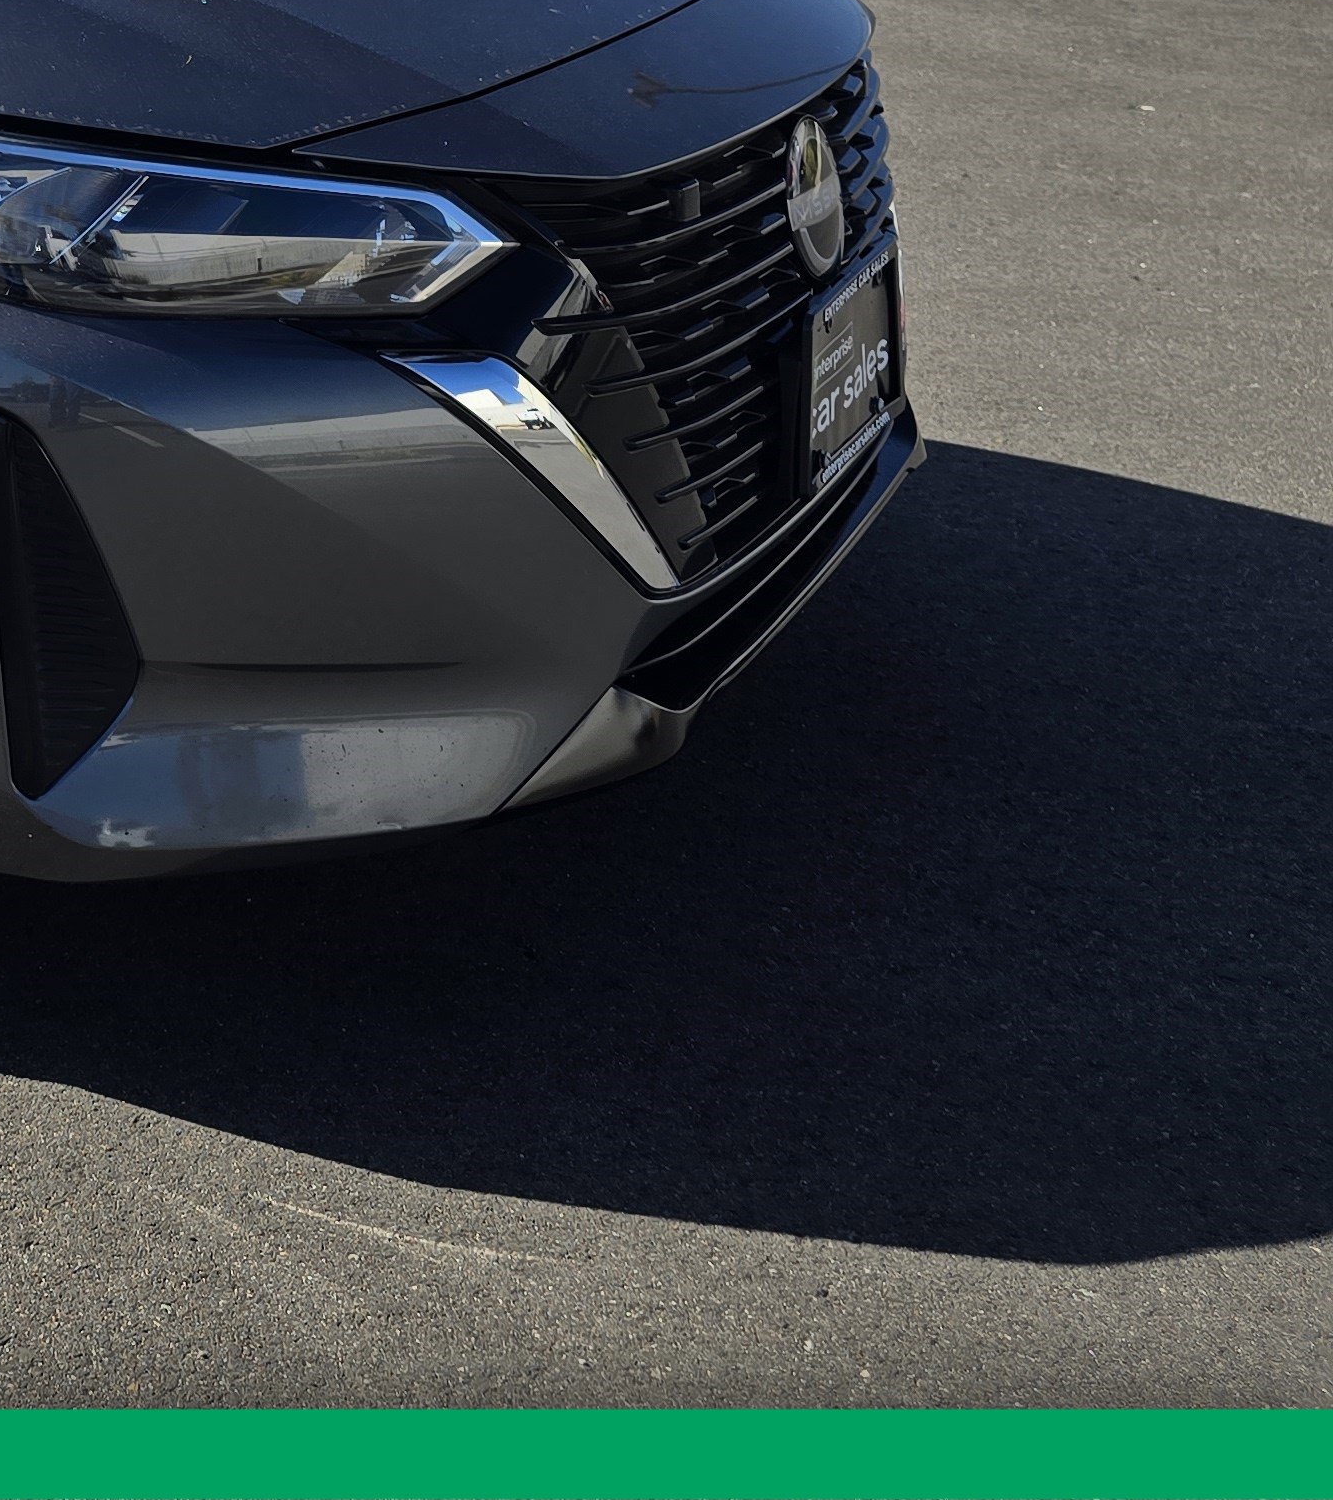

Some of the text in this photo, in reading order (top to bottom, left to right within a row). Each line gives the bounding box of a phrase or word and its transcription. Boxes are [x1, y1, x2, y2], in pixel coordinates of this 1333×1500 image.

[824, 250, 890, 322] ENTERPRISE CAR SALES
[843, 338, 889, 409] sales
[821, 411, 891, 484] enterprisecarsales.com
